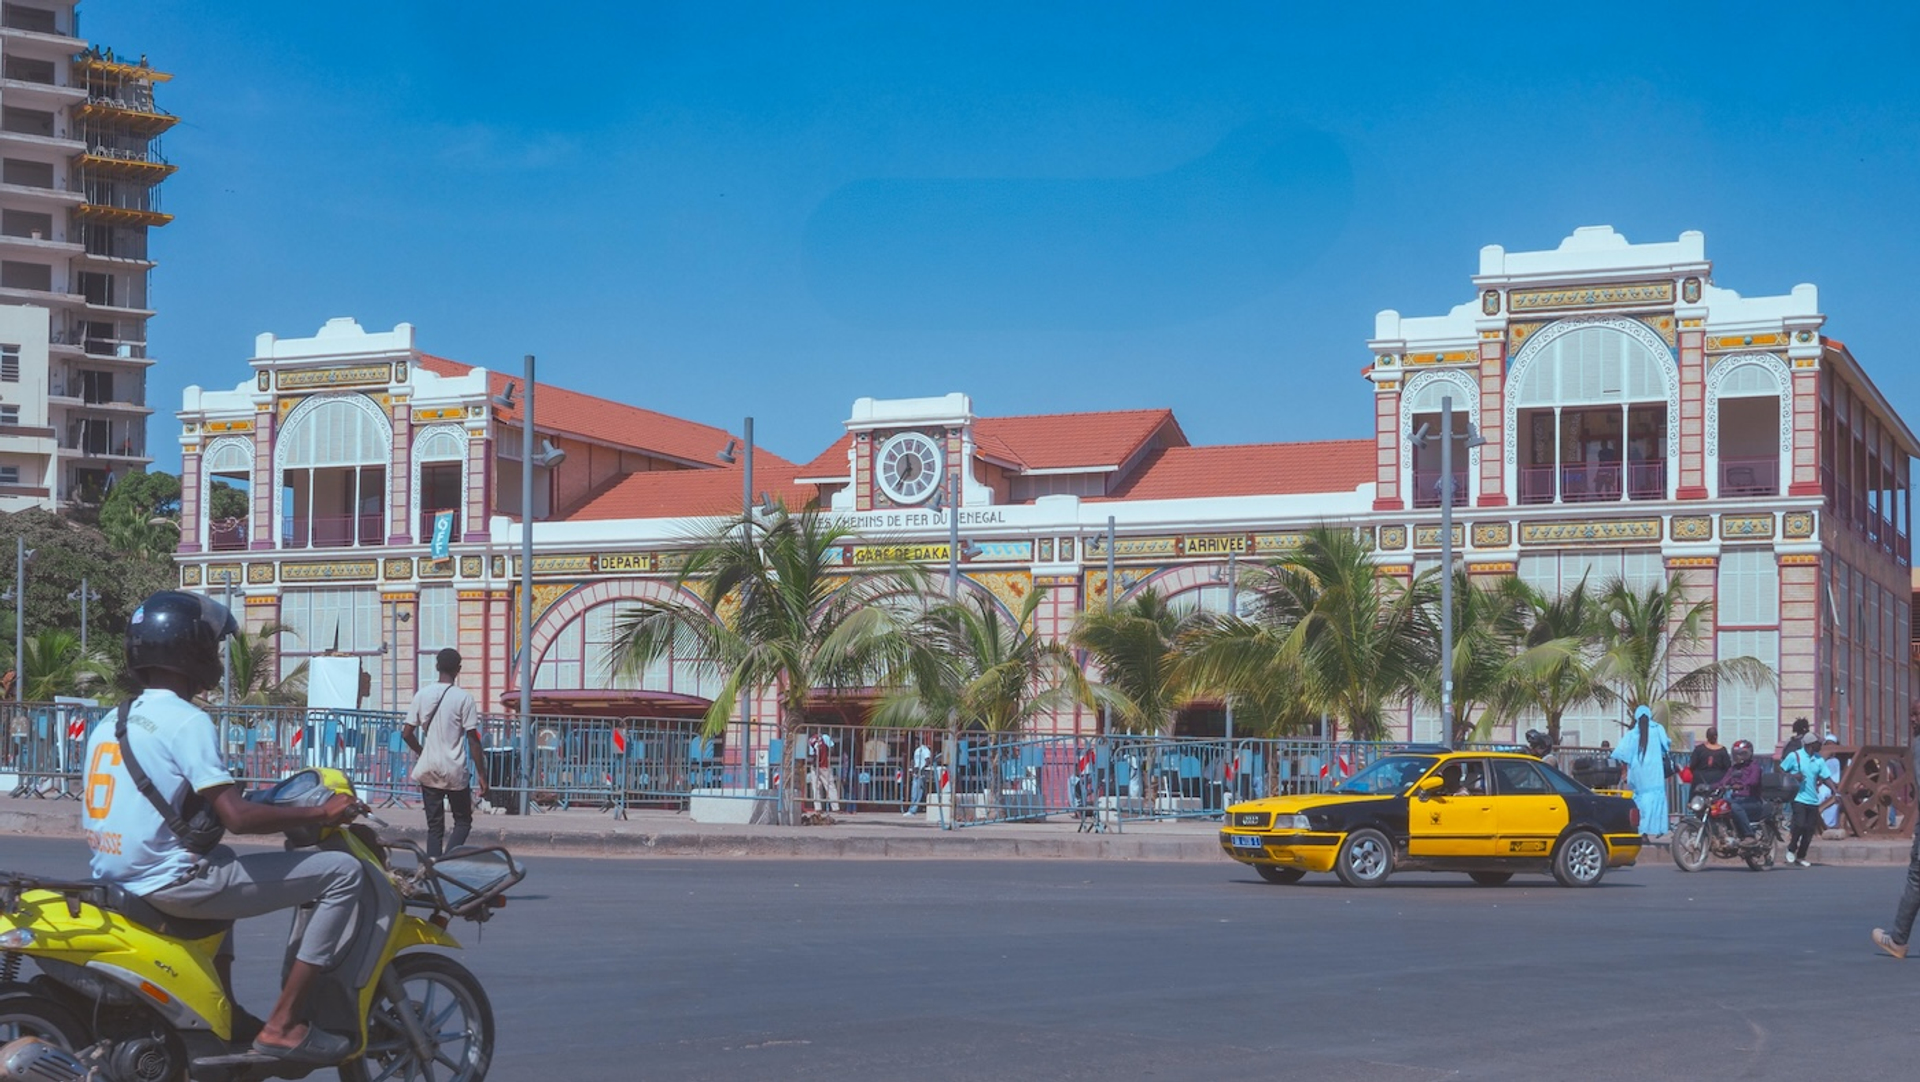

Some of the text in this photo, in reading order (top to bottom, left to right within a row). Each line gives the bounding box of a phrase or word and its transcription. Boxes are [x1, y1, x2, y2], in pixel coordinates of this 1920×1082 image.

[887, 515, 901, 527] DE
[905, 513, 928, 526] FER
[933, 512, 947, 525] DU
[958, 510, 1006, 524] ENEGAL
[436, 518, 449, 555] OFF
[1188, 537, 1244, 552] ARRIVEE
[855, 549, 891, 562] GARE
[914, 545, 952, 560] DAKA
[601, 556, 648, 569] DEPART
[85, 741, 122, 819] 6
